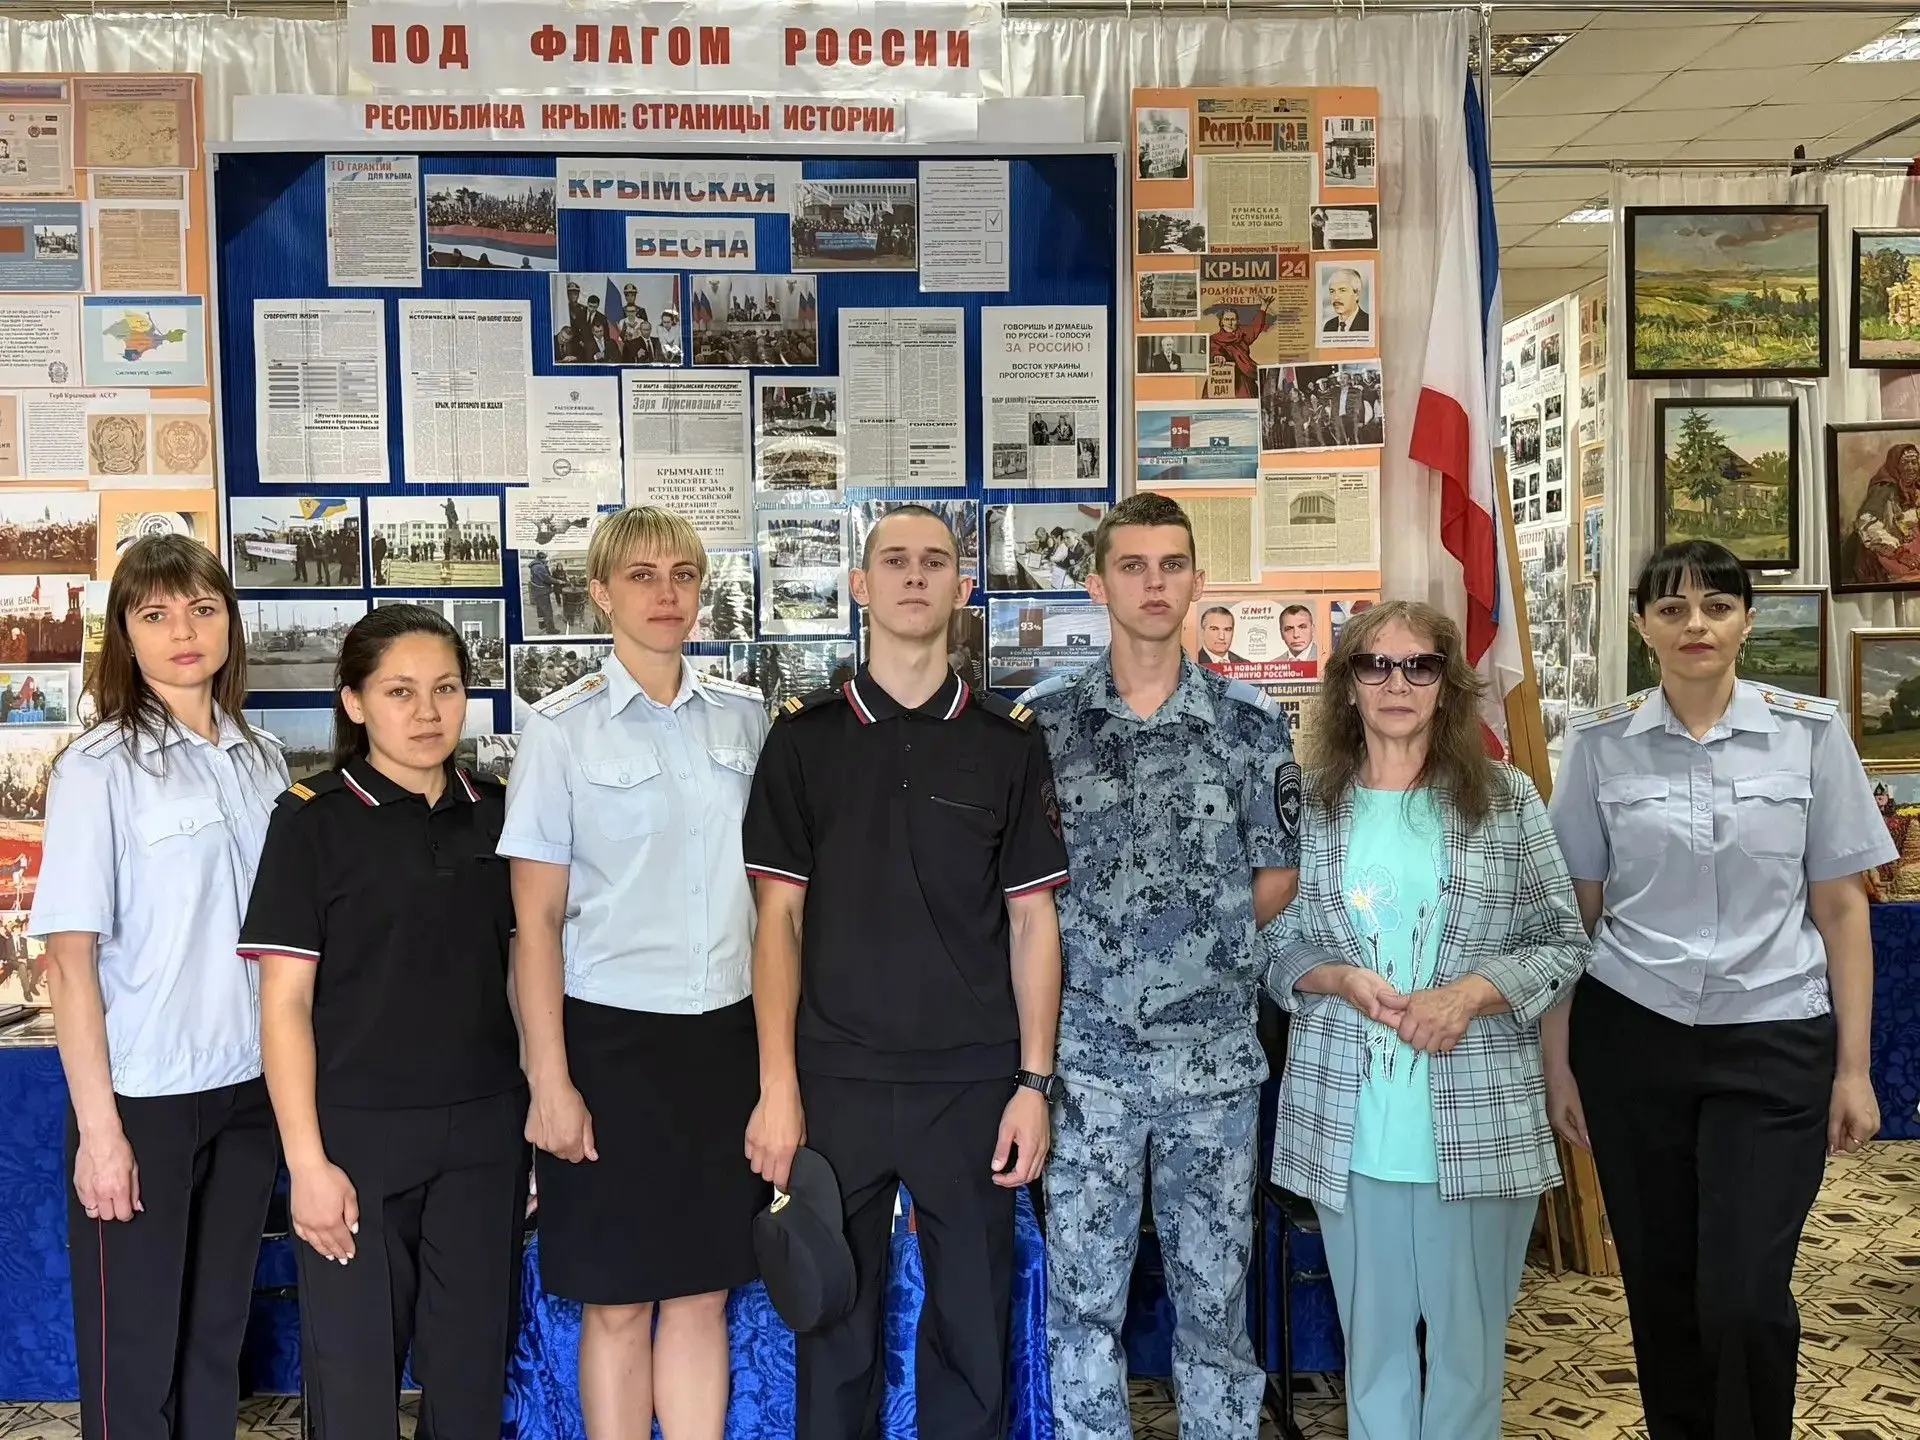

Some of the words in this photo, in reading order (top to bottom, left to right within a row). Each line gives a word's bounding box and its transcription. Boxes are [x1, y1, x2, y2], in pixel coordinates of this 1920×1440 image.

[371, 24, 469, 69] ПОД
[530, 24, 730, 66] ФЛАГОМ
[785, 27, 970, 67] РОССИИ
[365, 103, 525, 131] РЕСПУБЛИКА
[542, 103, 626, 130] КРЫМ:
[632, 102, 769, 133] СТРАНИЦЫ
[784, 104, 895, 132] ИСТОРИИ
[332, 160, 345, 172] 10
[347, 161, 392, 172] ГАРАНТИЙ
[368, 172, 384, 181] ДЛЯ
[385, 172, 413, 181] КРЫМА
[568, 170, 776, 203] КРЫМСКАЯ
[634, 228, 749, 258] ВЕСНА
[1205, 261, 1270, 278] КРЫМ
[1281, 260, 1306, 277] 24
[1003, 323, 1047, 331] ГОВОРИШЬ
[1018, 332, 1048, 340] РУССКИ
[1005, 343, 1022, 353] ЗА
[1028, 342, 1084, 353] РОССИЮ
[999, 371, 1054, 379] ПРОГОЛОСУЕТ
[1211, 368, 1232, 376] Скажи
[1214, 385, 1229, 396] ДА!
[632, 397, 657, 412] Заря
[661, 396, 722, 412] Присивашья
[1171, 427, 1190, 436] 93%
[657, 467, 713, 477] КРЫМЧАНЕ
[663, 477, 707, 485] ГОЛОСУЙТЕ
[699, 485, 726, 493] КРЫМА
[650, 493, 680, 501] СОСТАВ
[682, 492, 732, 501] РОССИЙСКОЙ
[664, 501, 710, 509] ФЕДЕРАЦИИ
[1250, 606, 1272, 615] №11
[1020, 621, 1042, 631] 93%
[1071, 635, 1087, 645] 7%
[1223, 665, 1233, 673] ЗА
[1234, 664, 1263, 672] НОВЫЙ
[1264, 663, 1291, 672] КРЫМ!
